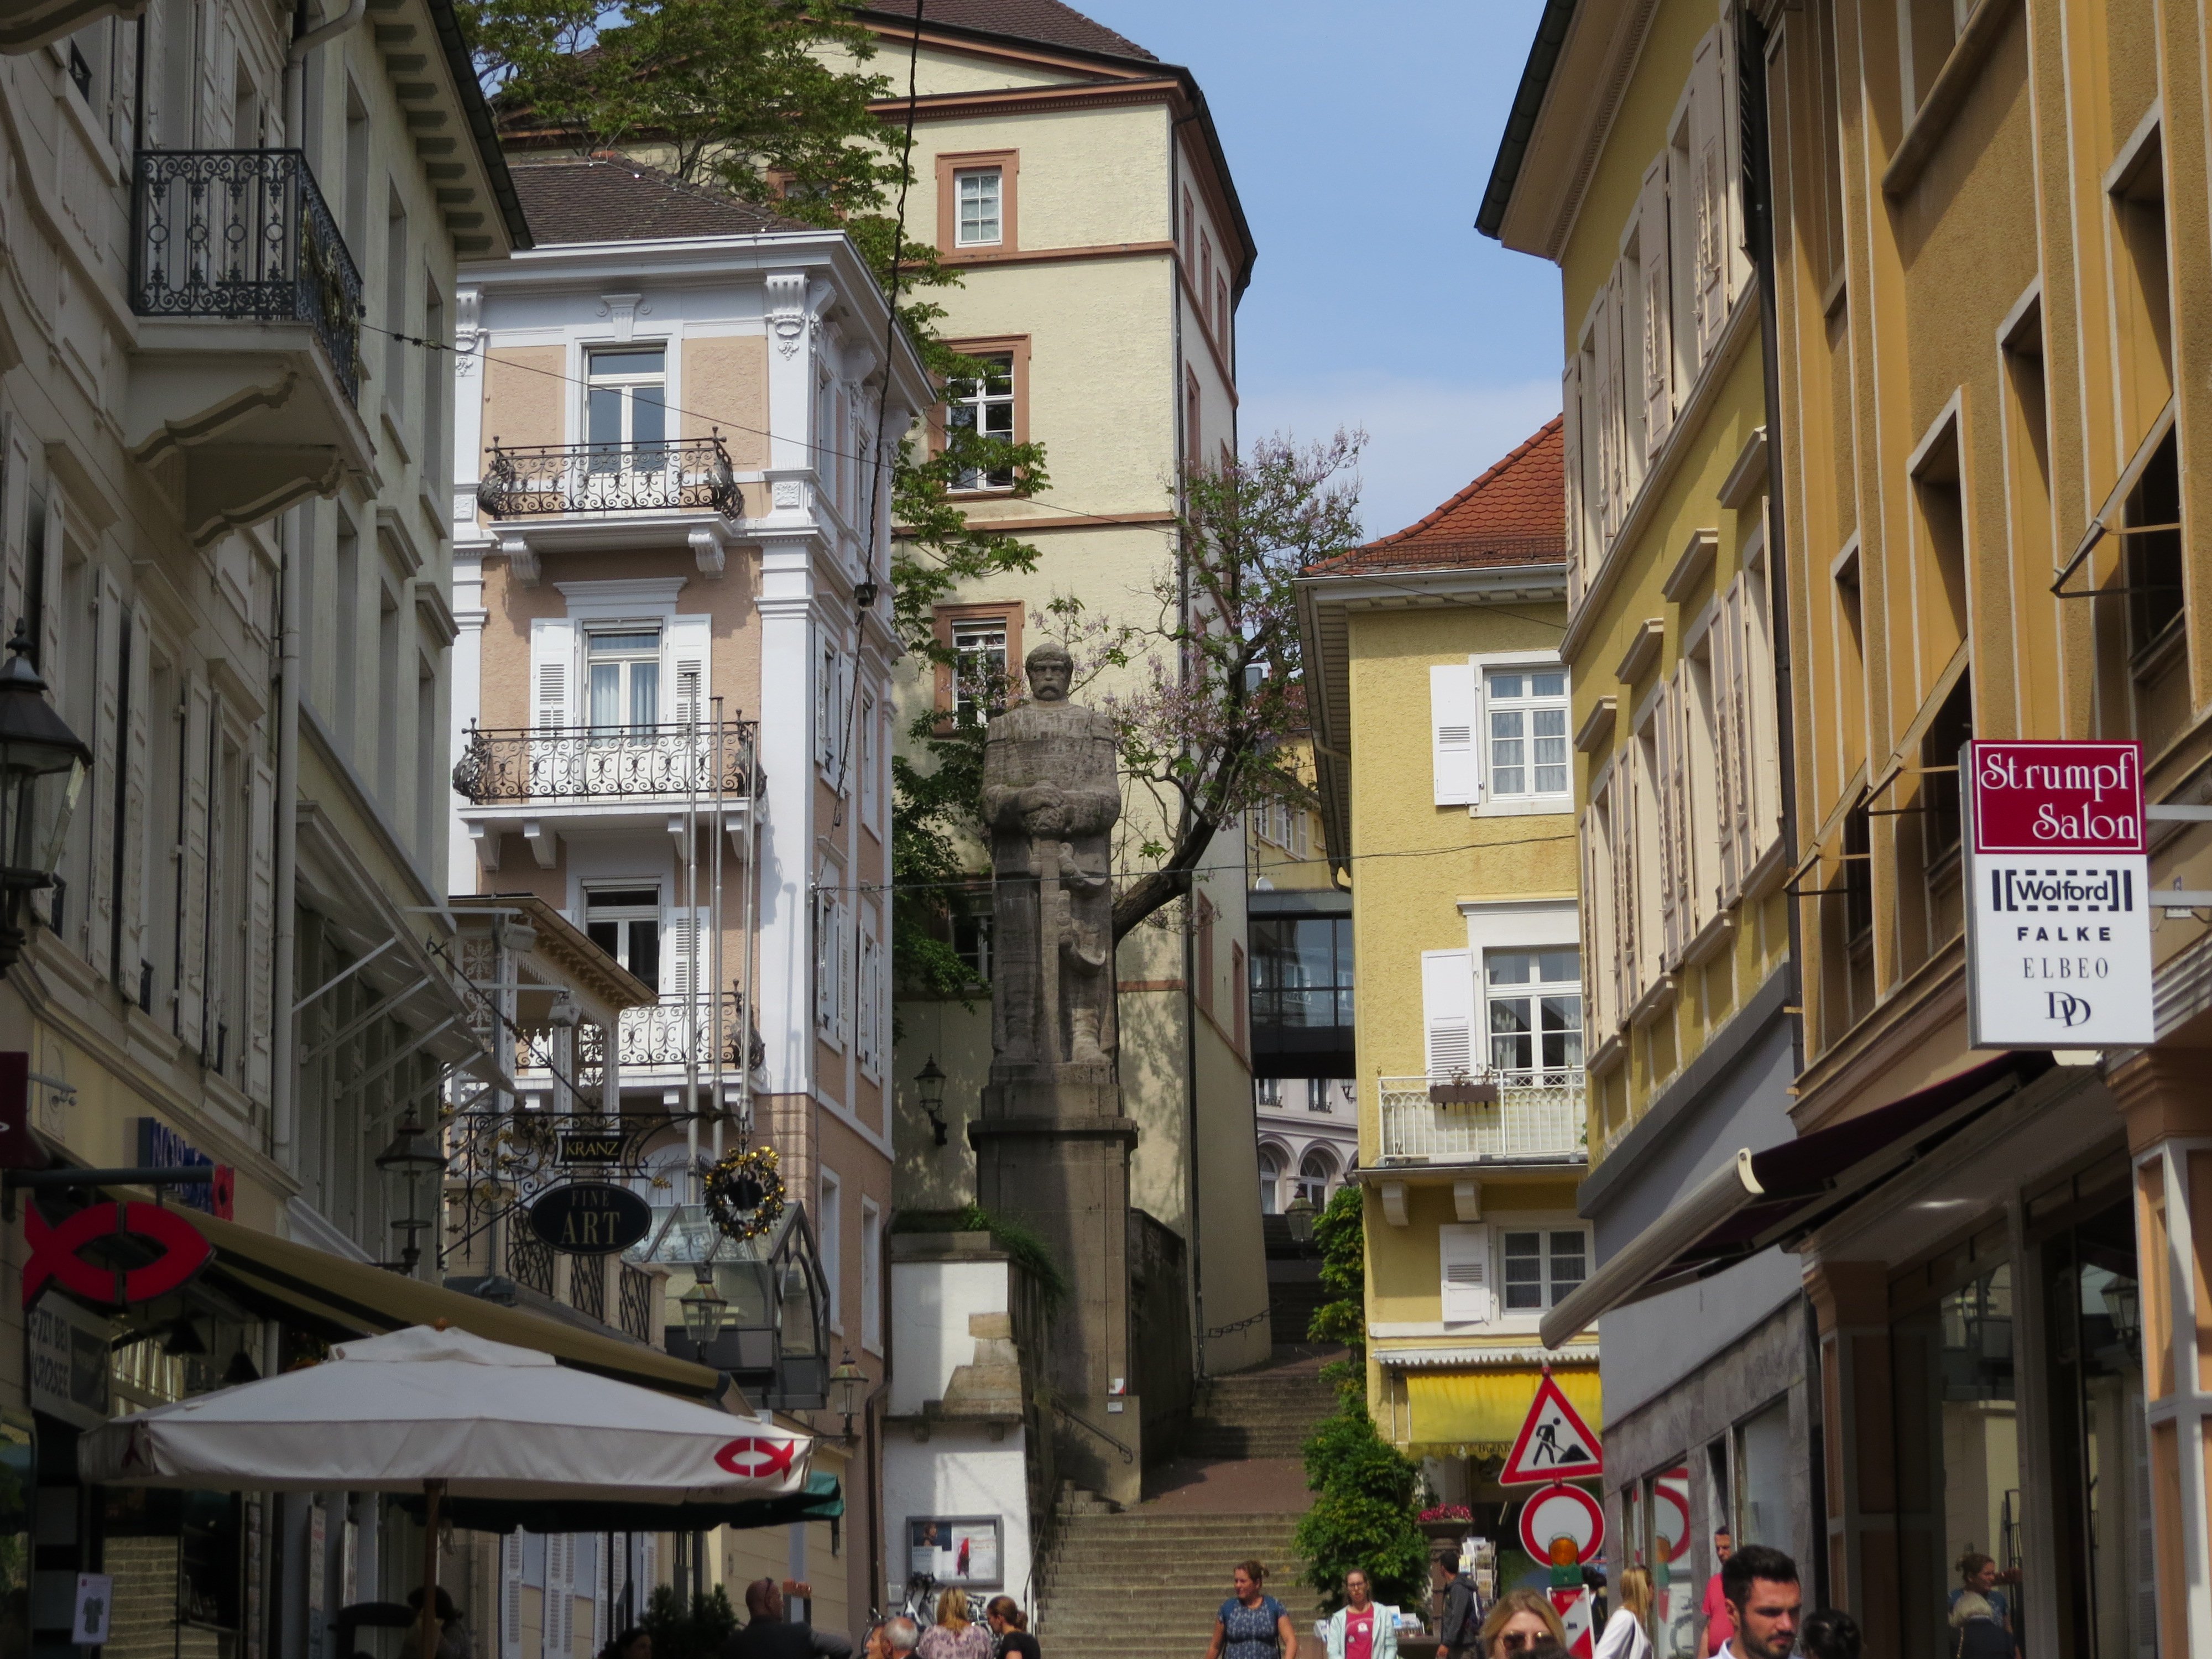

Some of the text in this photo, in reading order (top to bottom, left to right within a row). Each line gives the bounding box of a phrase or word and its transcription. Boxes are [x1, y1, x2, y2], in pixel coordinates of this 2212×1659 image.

[1980, 751, 2133, 802] Strumpf
[2032, 802, 2136, 839] Salon
[2016, 880, 2108, 900] Wolford
[2017, 927, 2110, 941] FALKE
[2023, 957, 2109, 978] ELBEO
[567, 1142, 618, 1156] KRANZ
[572, 1190, 609, 1206] FINE
[560, 1211, 620, 1244] ART
